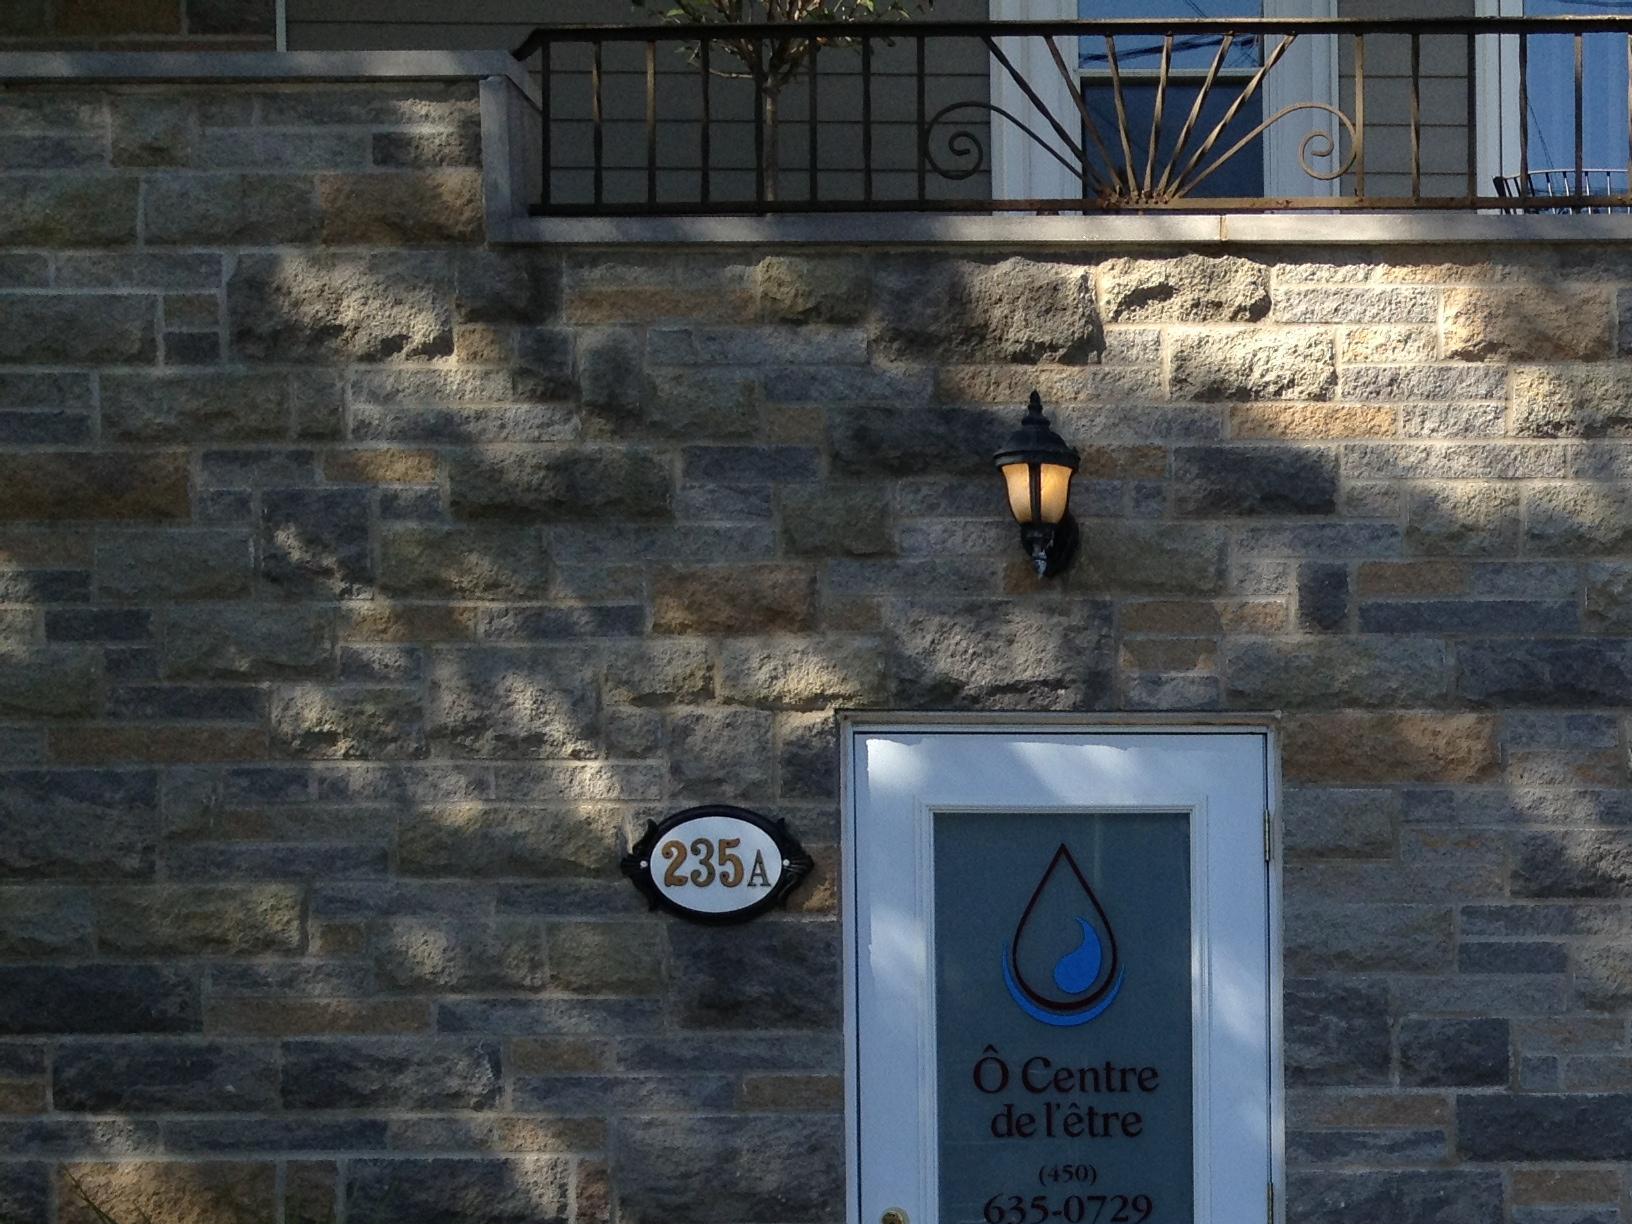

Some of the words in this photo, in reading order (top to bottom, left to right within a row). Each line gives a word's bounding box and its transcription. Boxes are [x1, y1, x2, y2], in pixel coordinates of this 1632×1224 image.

[661, 837, 771, 887] 235A
[973, 1044, 1010, 1095] Ô
[1021, 1056, 1160, 1095] Centre
[991, 1103, 1037, 1139] de
[1046, 1102, 1143, 1138] l'être
[1038, 1164, 1097, 1187] (450)
